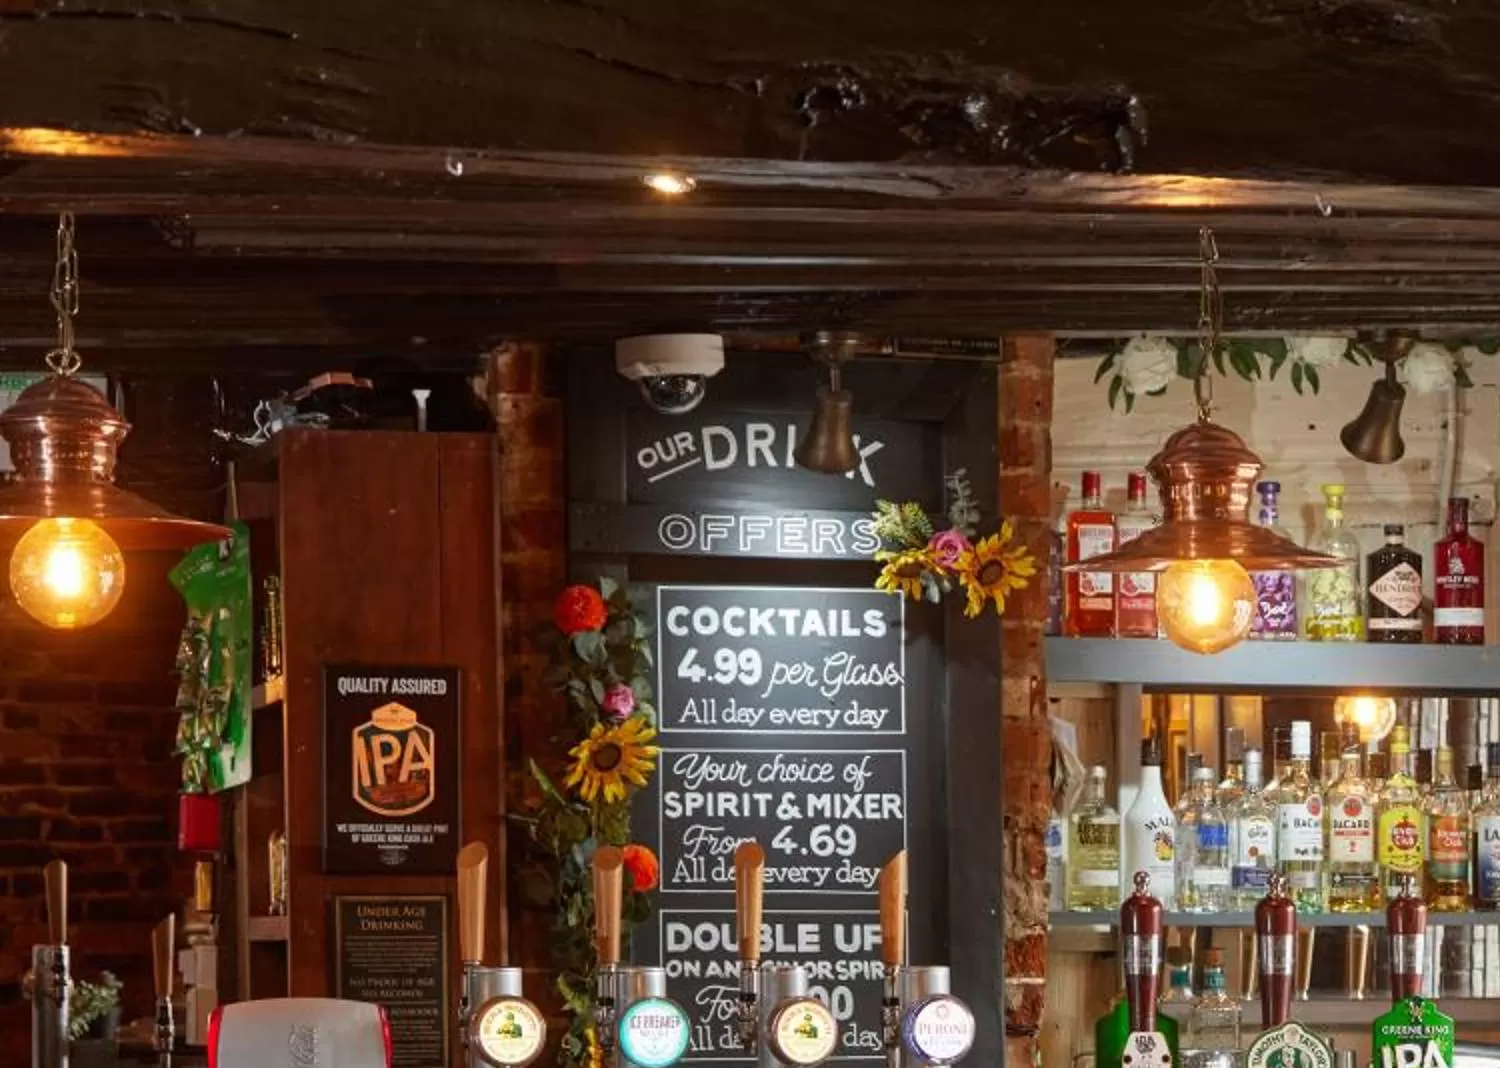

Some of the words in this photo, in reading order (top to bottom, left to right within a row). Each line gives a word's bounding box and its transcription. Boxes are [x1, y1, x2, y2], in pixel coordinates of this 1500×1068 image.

[637, 430, 697, 470] OUR
[701, 423, 885, 487] DRIK
[658, 513, 882, 555] OFFERS
[666, 605, 888, 638] COCKTAILS
[337, 676, 389, 696] QUALITY
[391, 677, 448, 696] ASSURED
[677, 648, 763, 685] 4.99
[762, 661, 819, 698] per
[820, 652, 905, 697] Glass
[678, 699, 717, 725] All
[721, 699, 765, 727] day
[769, 705, 841, 728] every
[843, 701, 889, 729] day
[354, 729, 433, 788] IPA
[673, 754, 752, 789] Your
[757, 756, 836, 783] choice
[843, 755, 872, 792] of
[664, 792, 771, 819] SPIRIT
[776, 792, 803, 820] &
[807, 793, 904, 819] MIXER
[771, 824, 857, 857] 4.69
[672, 857, 706, 883] All
[711, 857, 737, 883] da
[762, 865, 831, 887] every
[836, 859, 881, 888] day
[665, 959, 700, 979] ON
[704, 959, 741, 979] AN
[836, 959, 885, 981] SPIR
[719, 1024, 743, 1050] da
[843, 1023, 882, 1051] day
